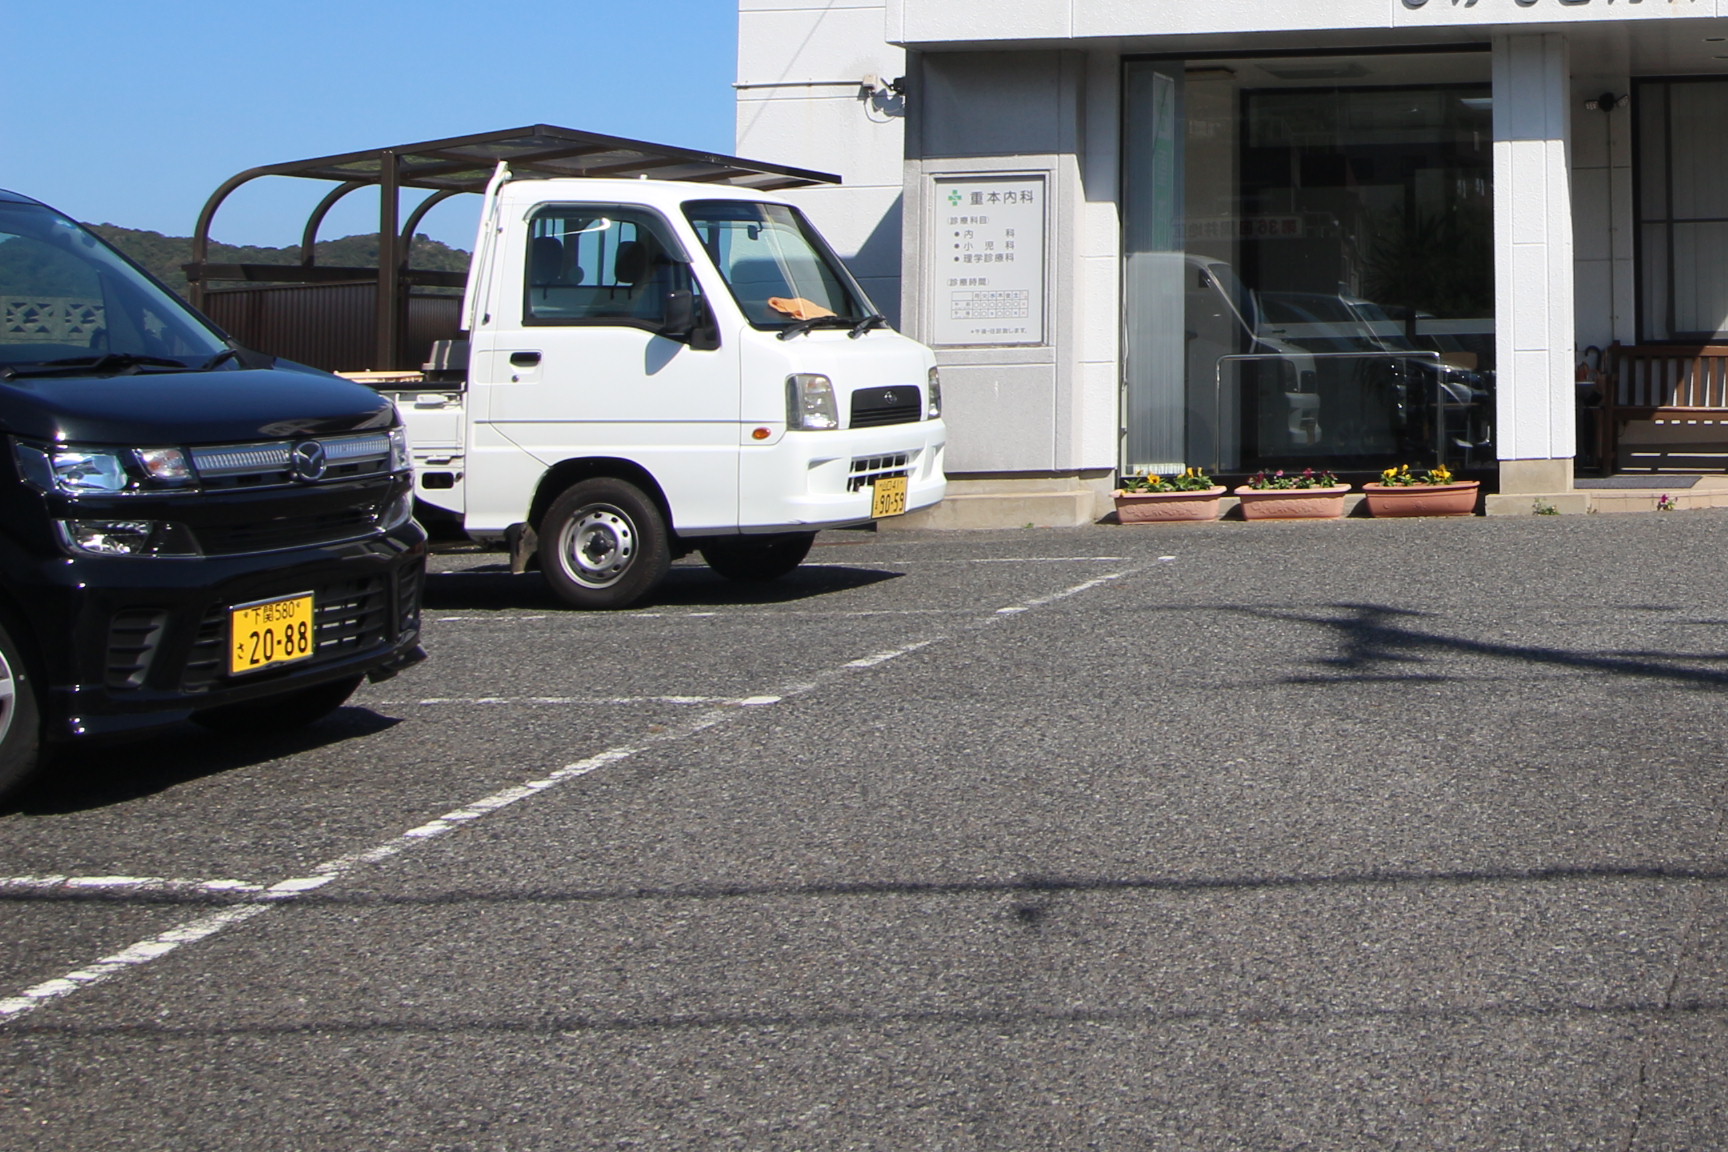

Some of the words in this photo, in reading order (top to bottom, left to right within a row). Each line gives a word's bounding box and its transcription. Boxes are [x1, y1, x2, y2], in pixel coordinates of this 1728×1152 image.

[970, 190, 1033, 205] 重本内科
[880, 492, 904, 514] 90-59
[249, 621, 308, 665] 20-88
